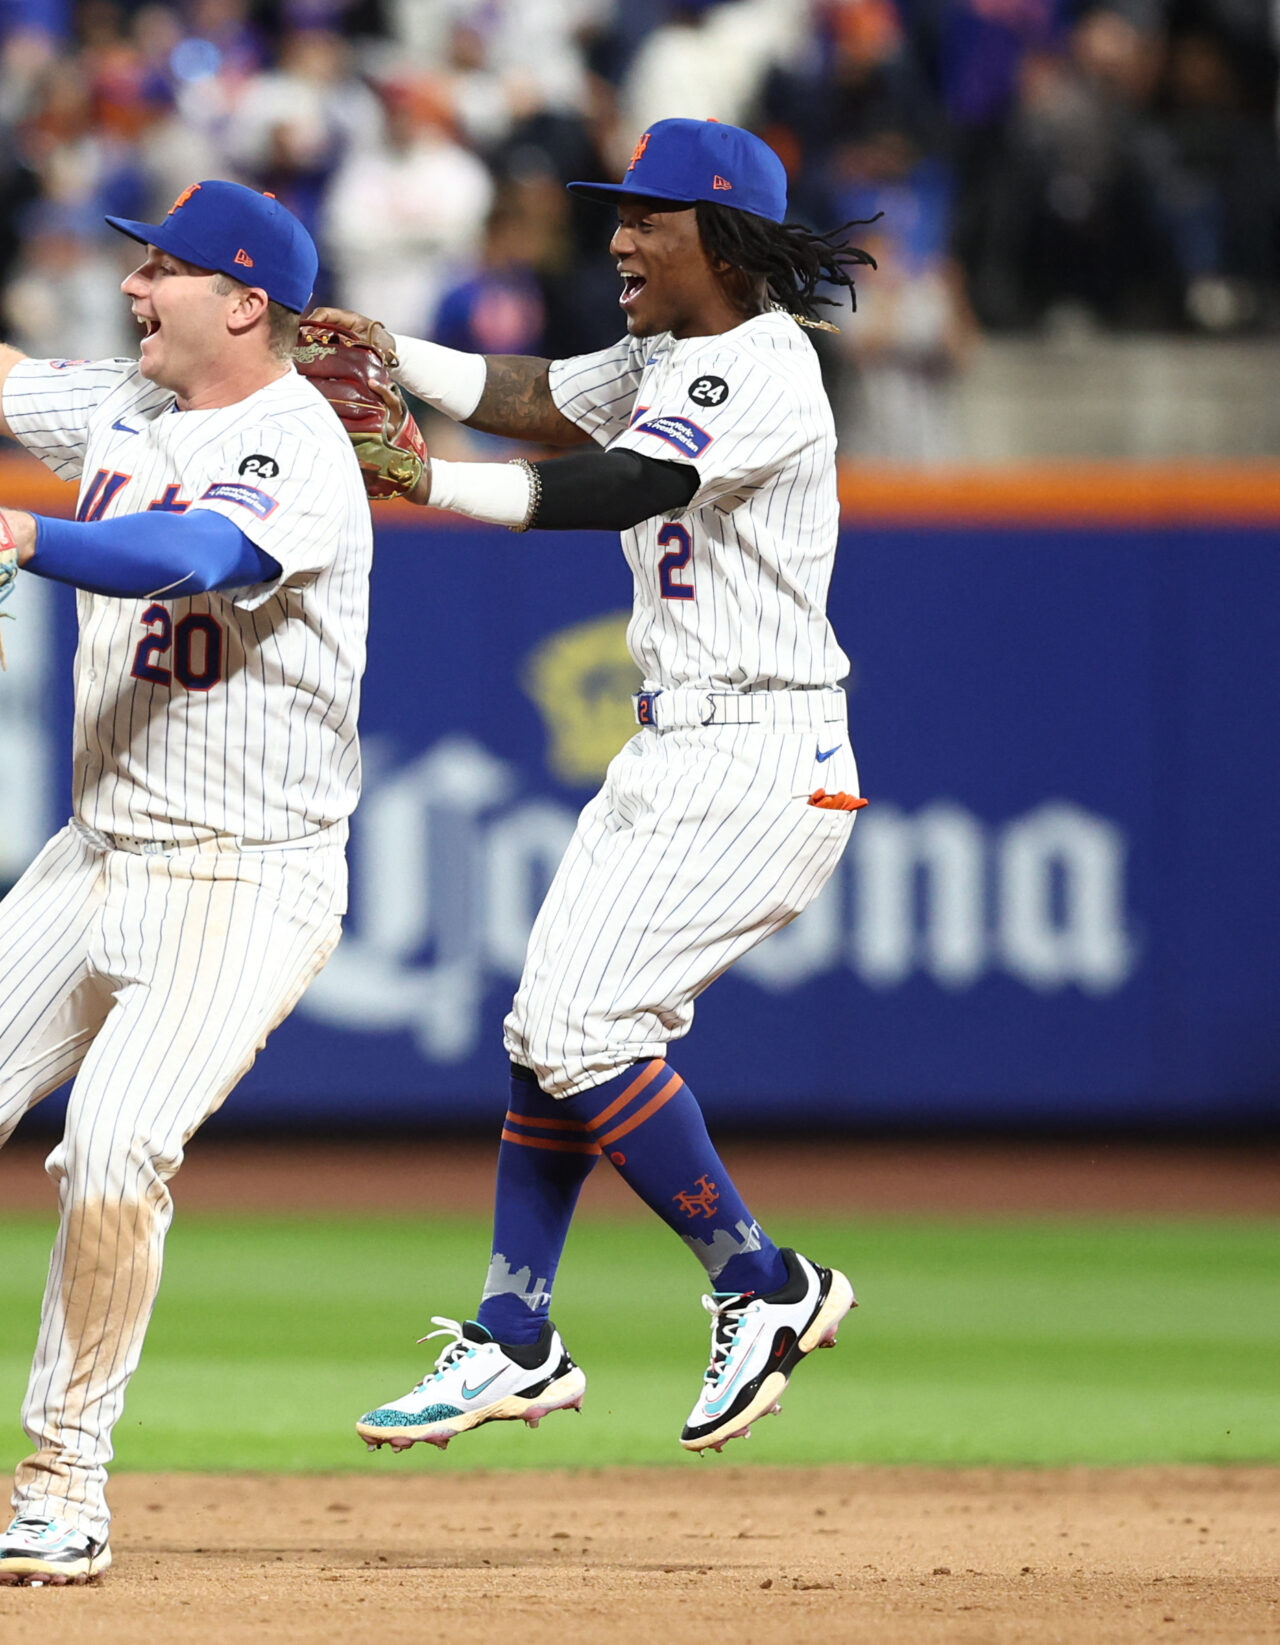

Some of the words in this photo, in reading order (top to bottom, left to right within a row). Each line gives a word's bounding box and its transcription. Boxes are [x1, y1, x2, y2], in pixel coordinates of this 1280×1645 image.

[691, 379, 726, 404] 24
[243, 459, 275, 478] 24
[657, 522, 695, 601] 2
[130, 602, 223, 692] 20
[639, 700, 649, 722] 2
[298, 733, 1134, 1064] Cona
